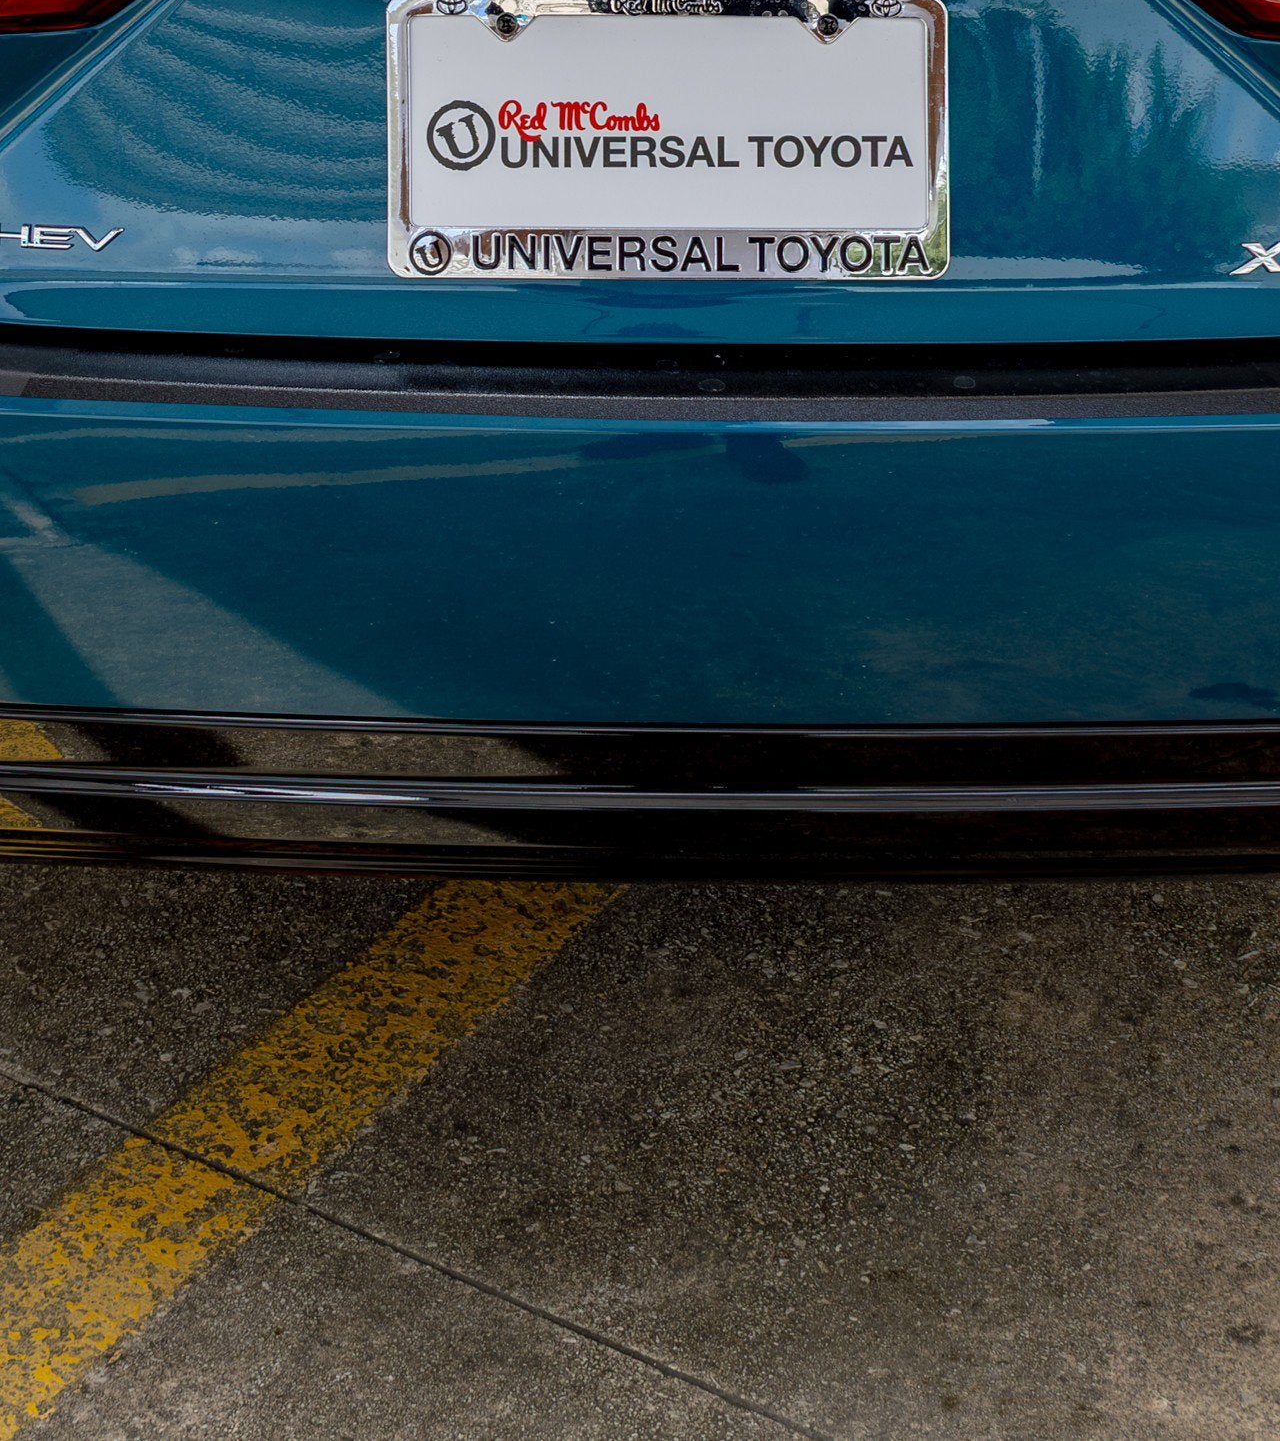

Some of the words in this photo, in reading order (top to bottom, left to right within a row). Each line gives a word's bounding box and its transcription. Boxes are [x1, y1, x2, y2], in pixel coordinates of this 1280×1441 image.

[498, 99, 547, 142] Red
[551, 100, 660, 132] McCombs
[500, 135, 740, 169] UNIVERSAL
[748, 135, 914, 168] TOYOTA
[471, 234, 741, 273] UNIVERSAL
[747, 234, 933, 274] TOYOTA
